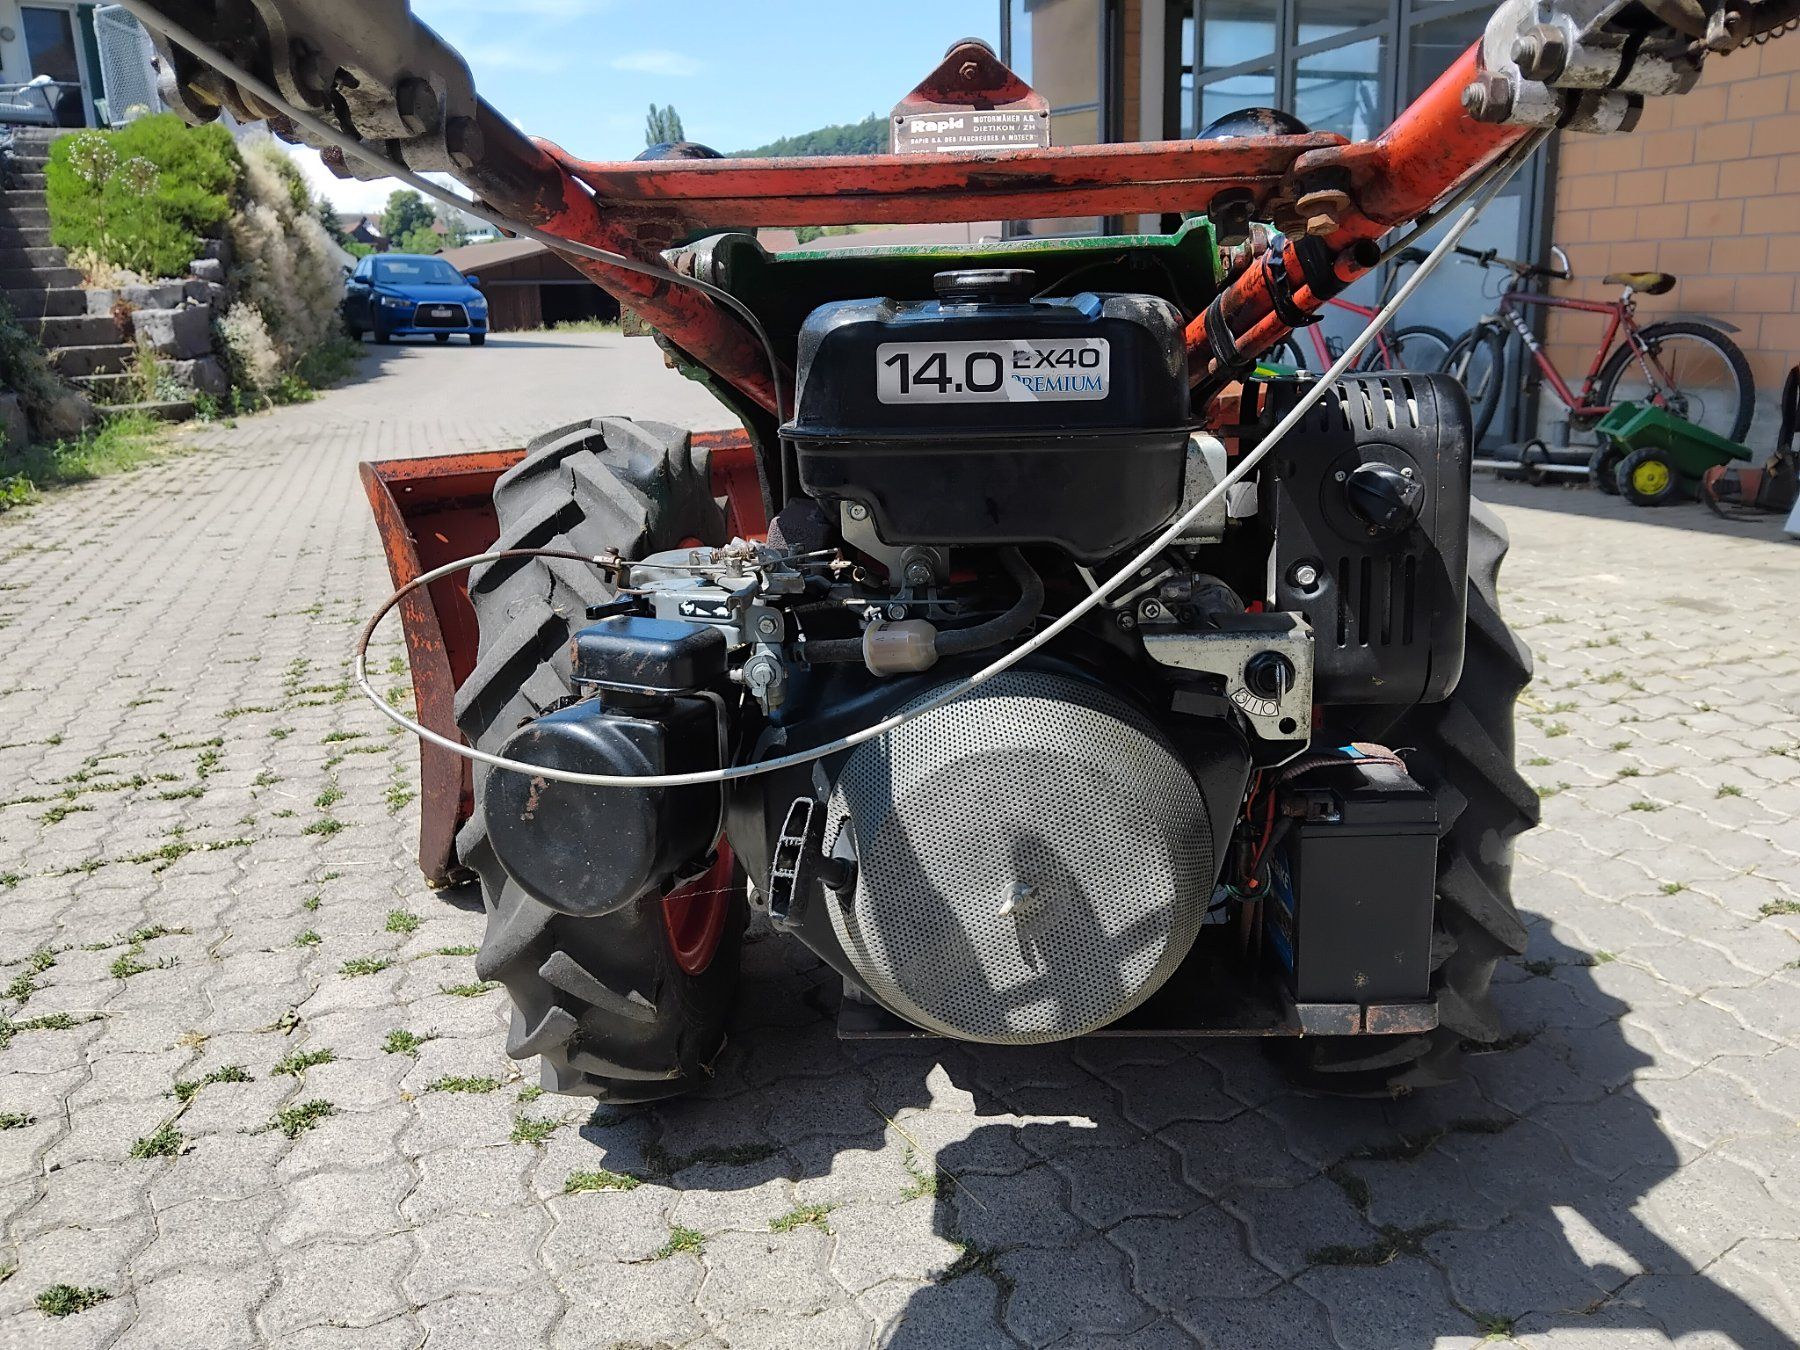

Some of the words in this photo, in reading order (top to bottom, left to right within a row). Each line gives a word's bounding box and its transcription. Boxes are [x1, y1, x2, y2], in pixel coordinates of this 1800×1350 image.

[911, 117, 963, 133] Rapid
[1013, 348, 1100, 369] EX40
[884, 351, 1004, 394] 14.0
